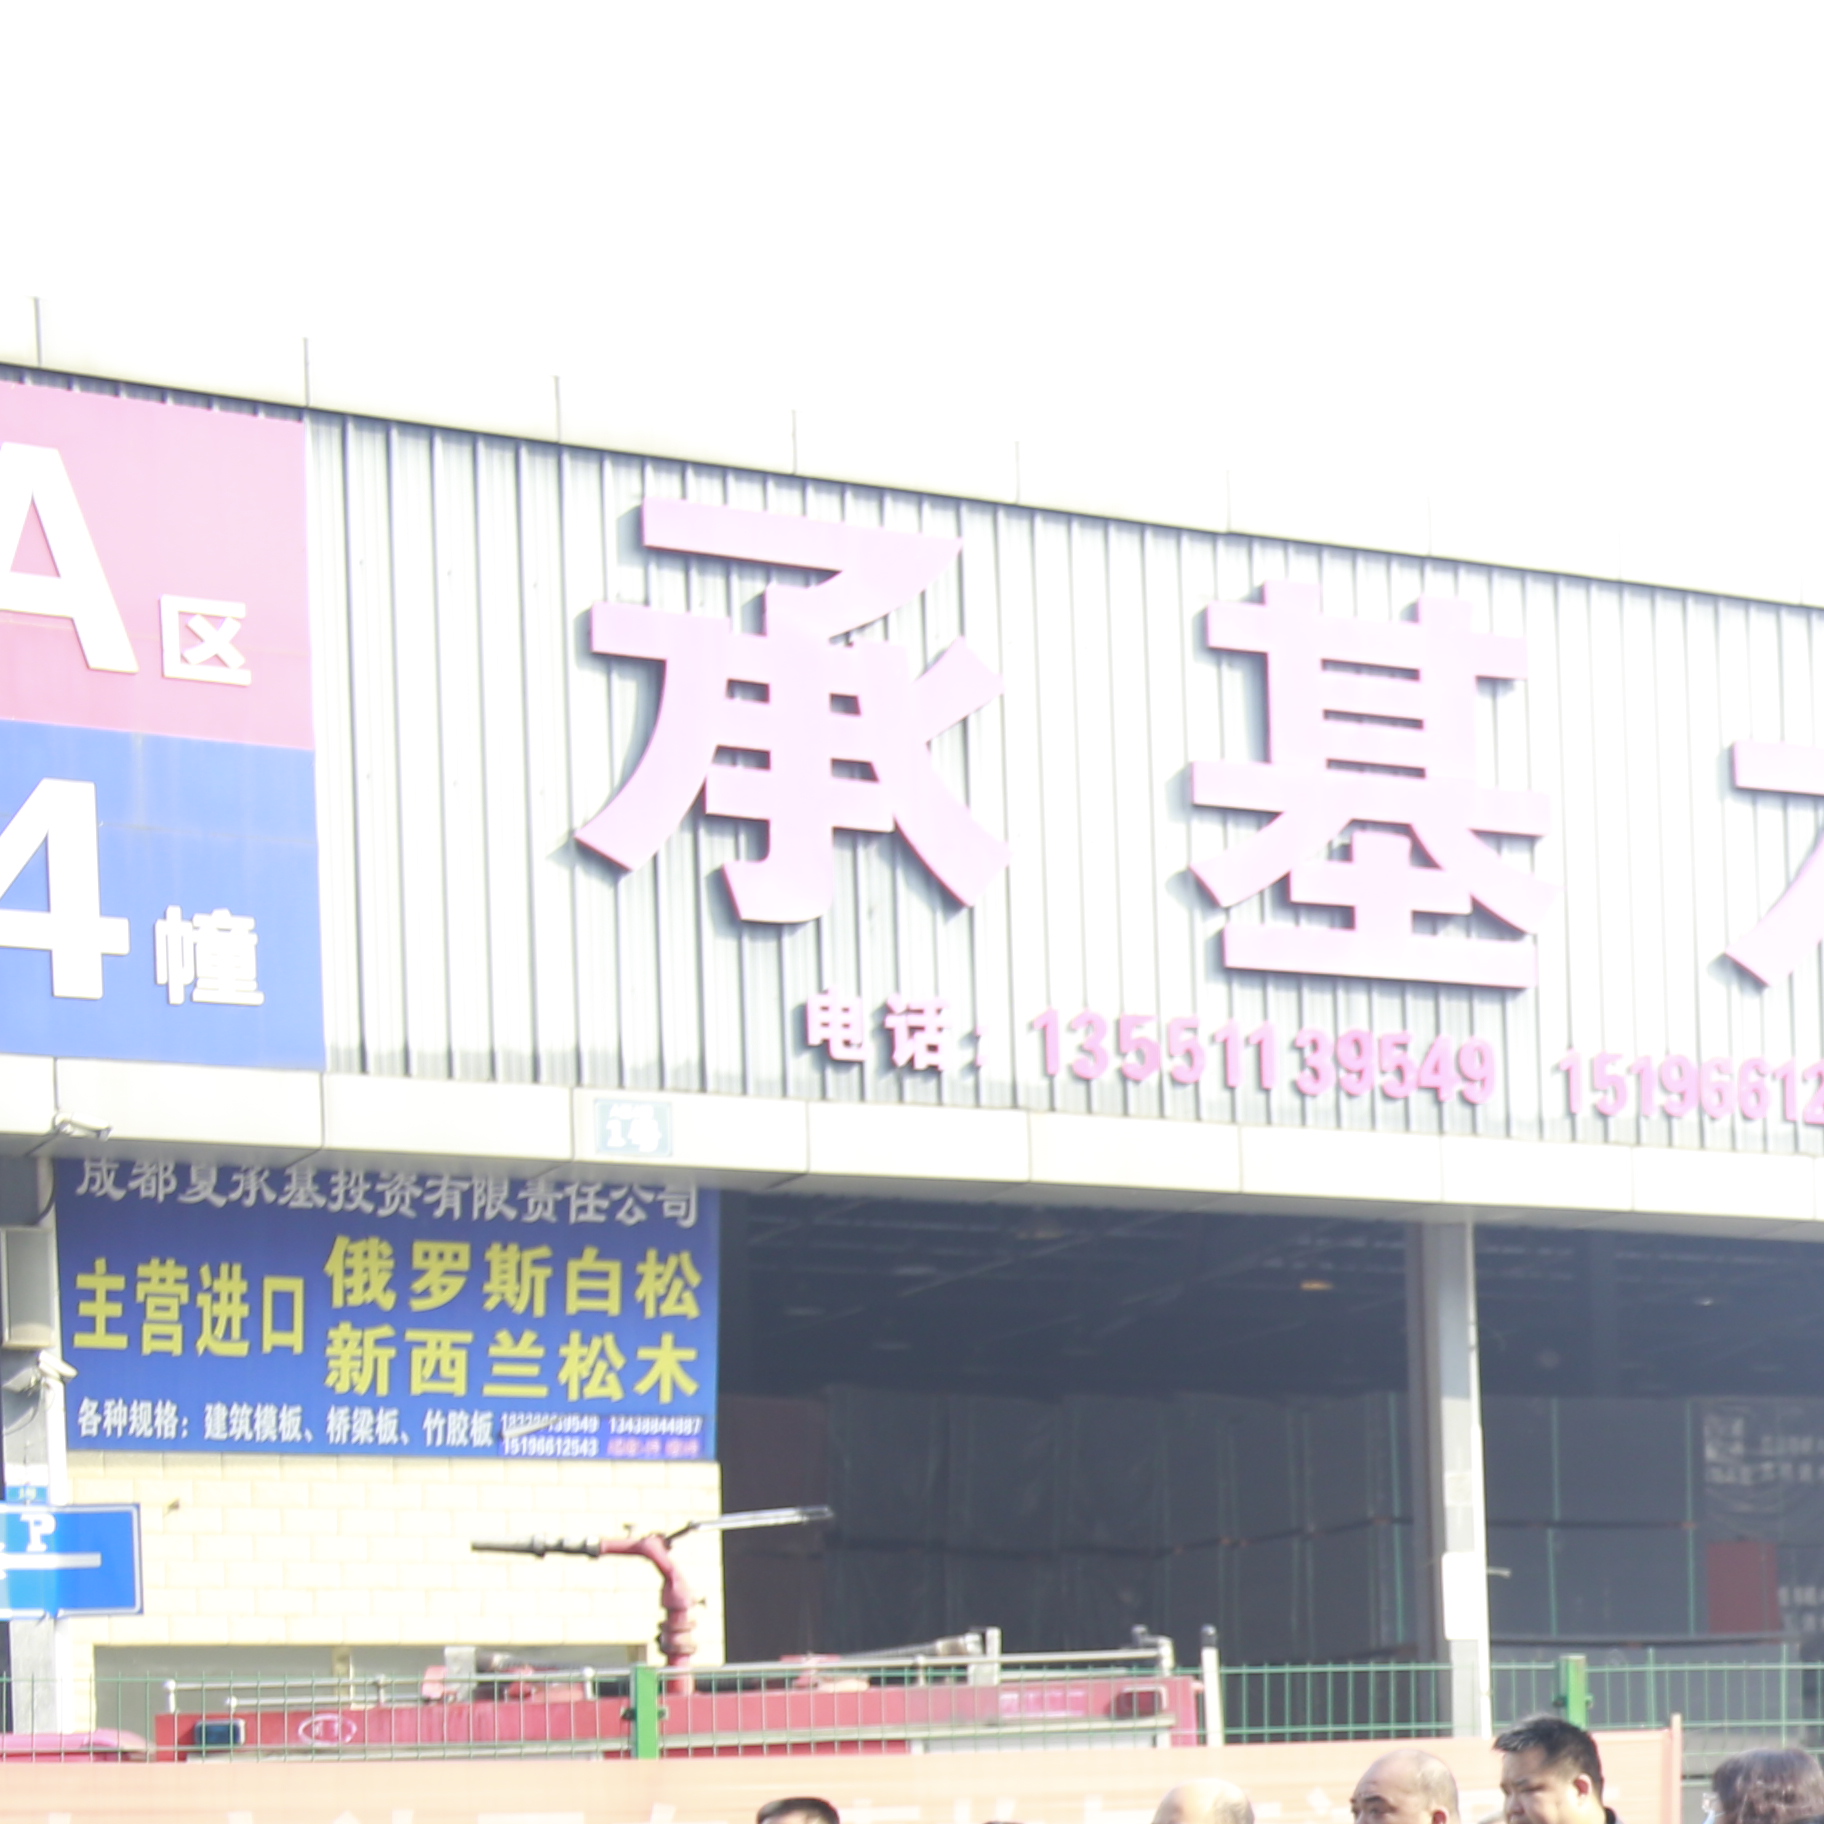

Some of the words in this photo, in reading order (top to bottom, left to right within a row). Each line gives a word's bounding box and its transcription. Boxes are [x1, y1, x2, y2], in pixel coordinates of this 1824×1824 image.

[1034, 1006, 1497, 1104] 13551139549
[73, 1257, 305, 1358] 主营进口
[324, 1235, 702, 1320] 俄罗斯白松
[324, 1321, 700, 1404] 新西兰松木
[20, 1513, 57, 1552] P
